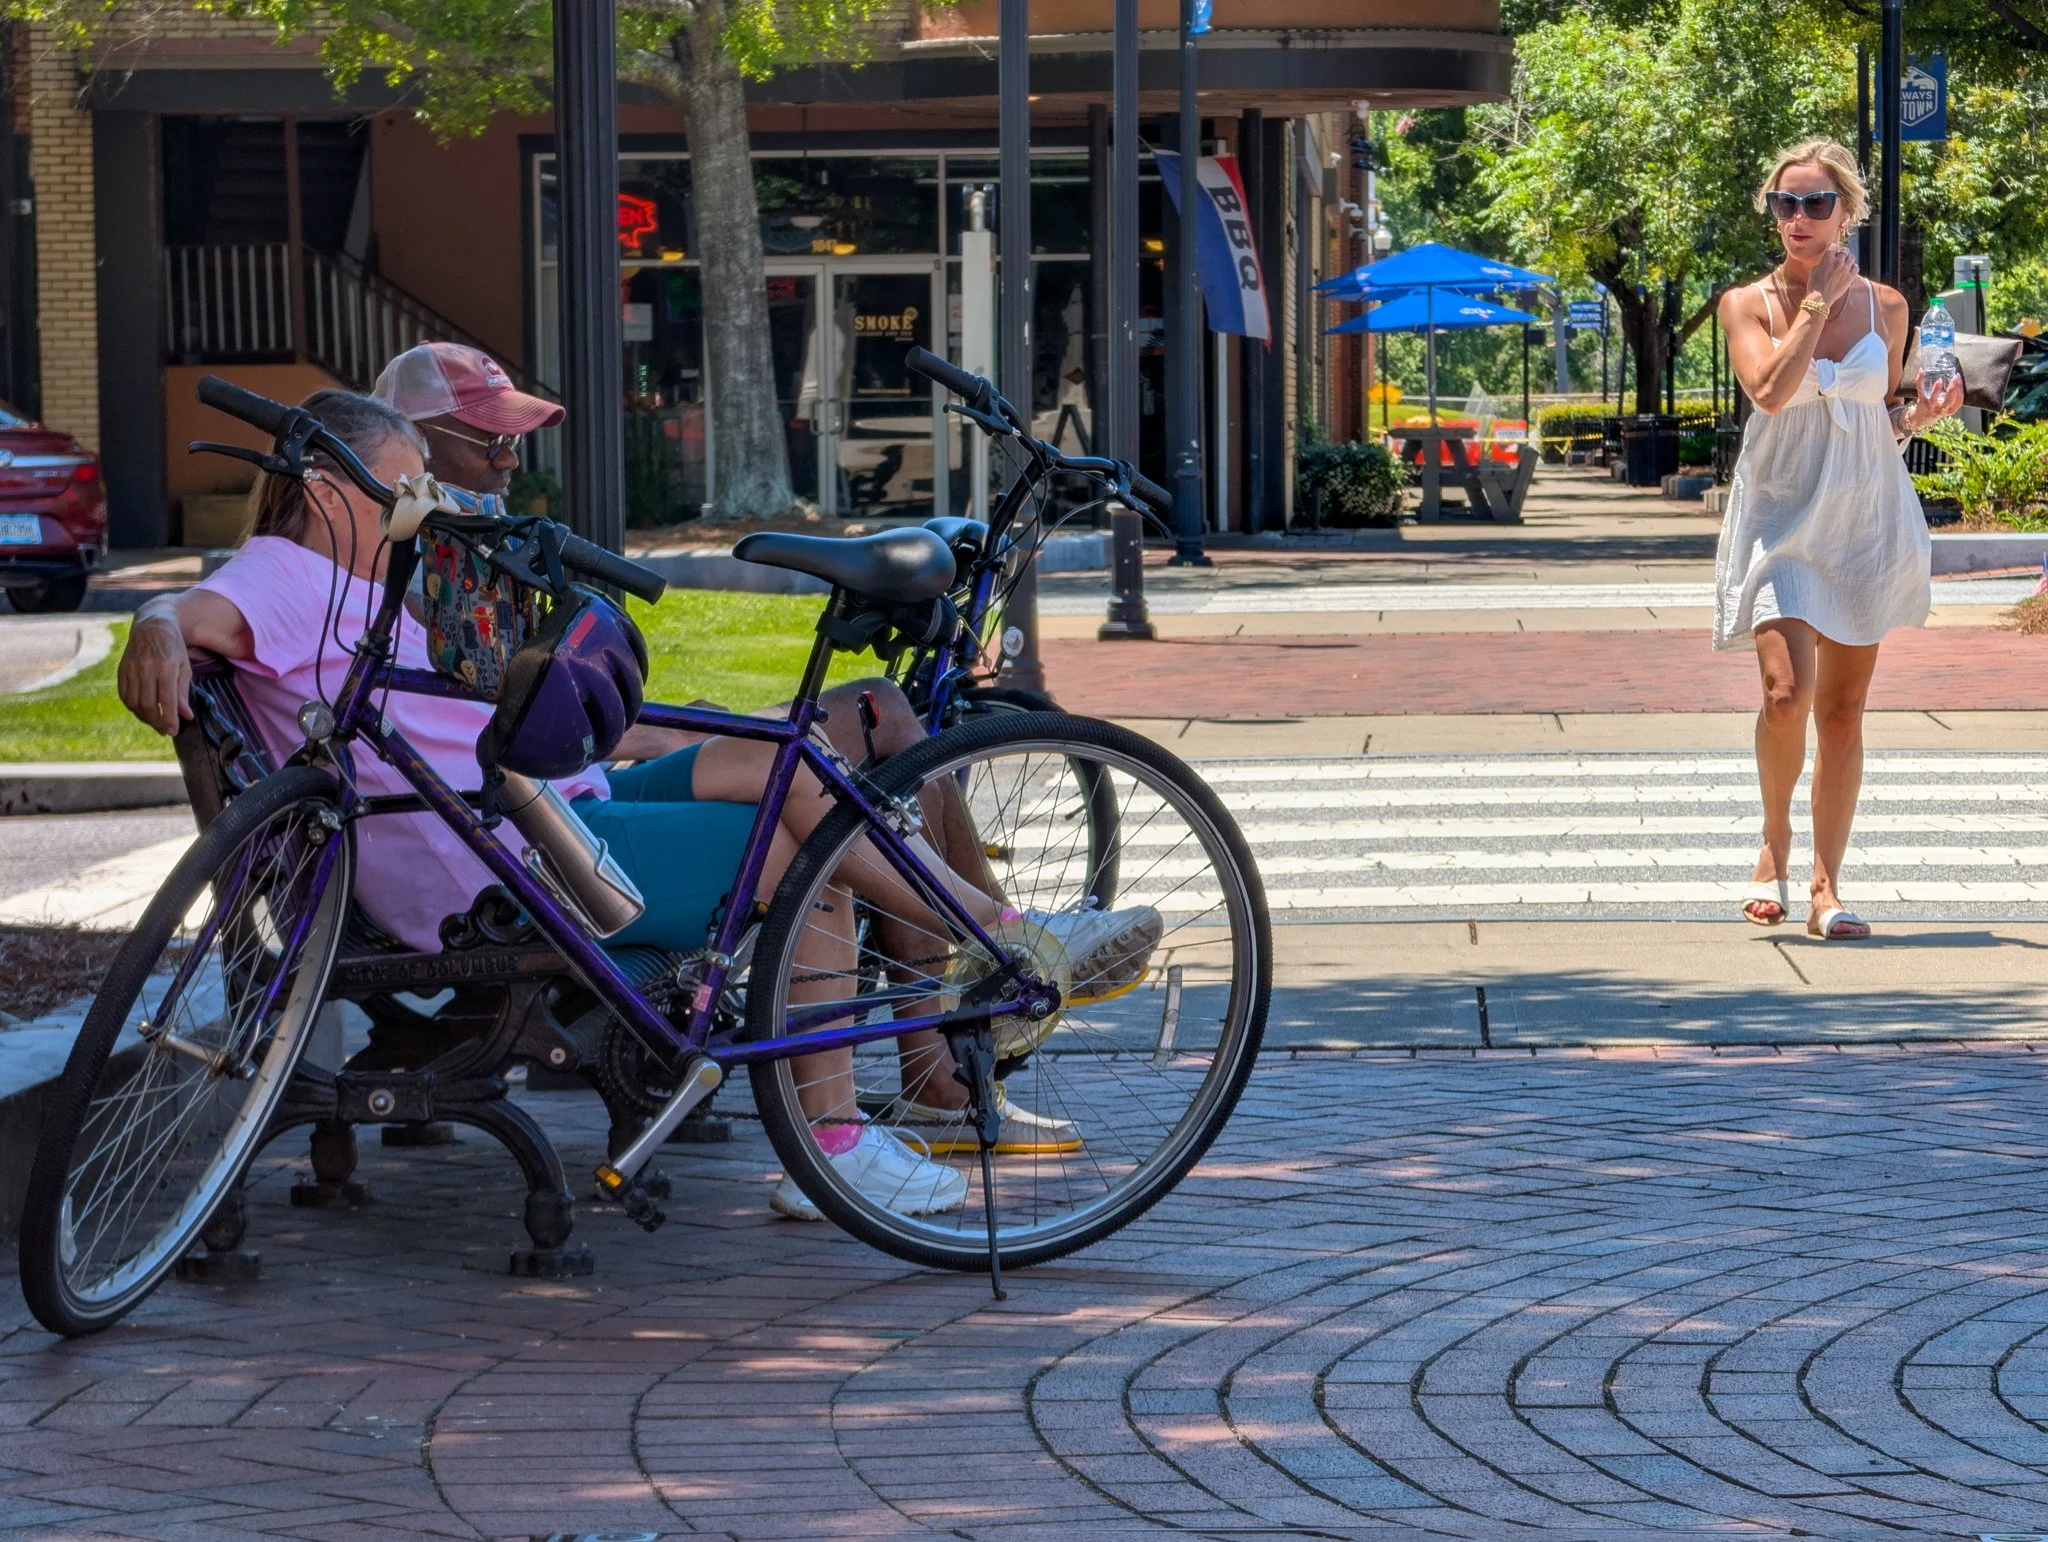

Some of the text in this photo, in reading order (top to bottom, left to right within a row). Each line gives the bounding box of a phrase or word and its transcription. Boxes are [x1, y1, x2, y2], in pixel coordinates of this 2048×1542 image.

[1900, 91, 1933, 100] WAYS
[1900, 101, 1933, 120] TOWN
[618, 207, 644, 225] EN
[1207, 186, 1259, 291] BBQ
[854, 315, 913, 331] SMOKE
